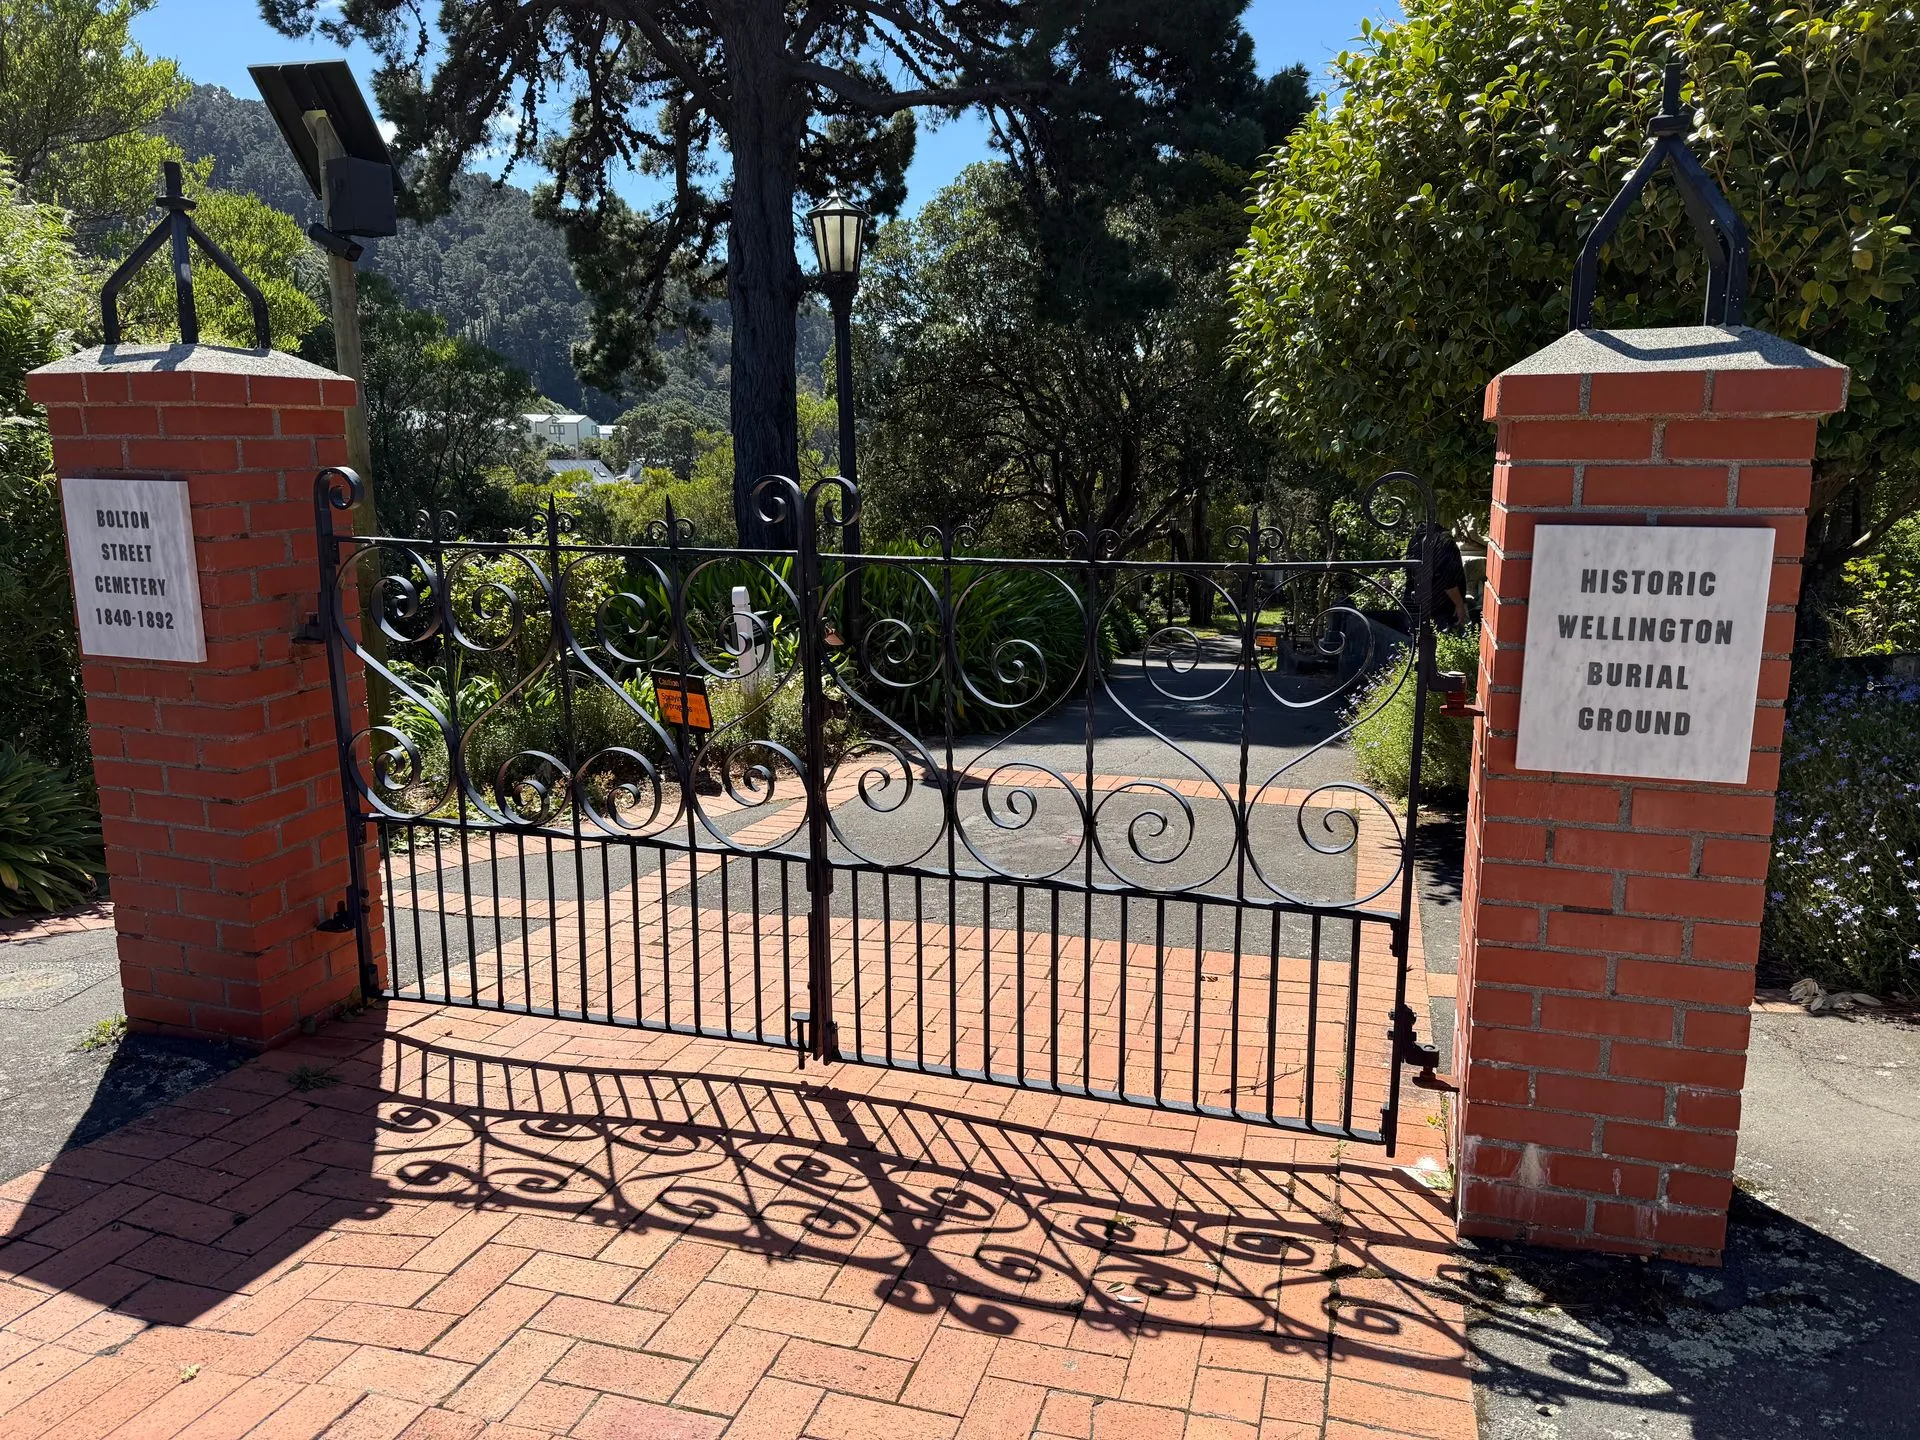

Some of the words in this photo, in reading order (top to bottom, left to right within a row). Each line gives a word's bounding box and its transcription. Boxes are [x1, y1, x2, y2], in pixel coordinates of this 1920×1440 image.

[96, 509, 150, 529] BOLTON
[101, 543, 152, 562] STREET
[94, 575, 166, 596] CEMETERY
[1580, 568, 1717, 597] HISTORIC
[95, 607, 175, 630] 1840-1892
[1557, 614, 1734, 645] WELLINGTON
[658, 677, 680, 687] Caution
[1587, 661, 1689, 690] BURIAL
[662, 692, 682, 703] Sprayin
[1577, 706, 1692, 736] GROUND
